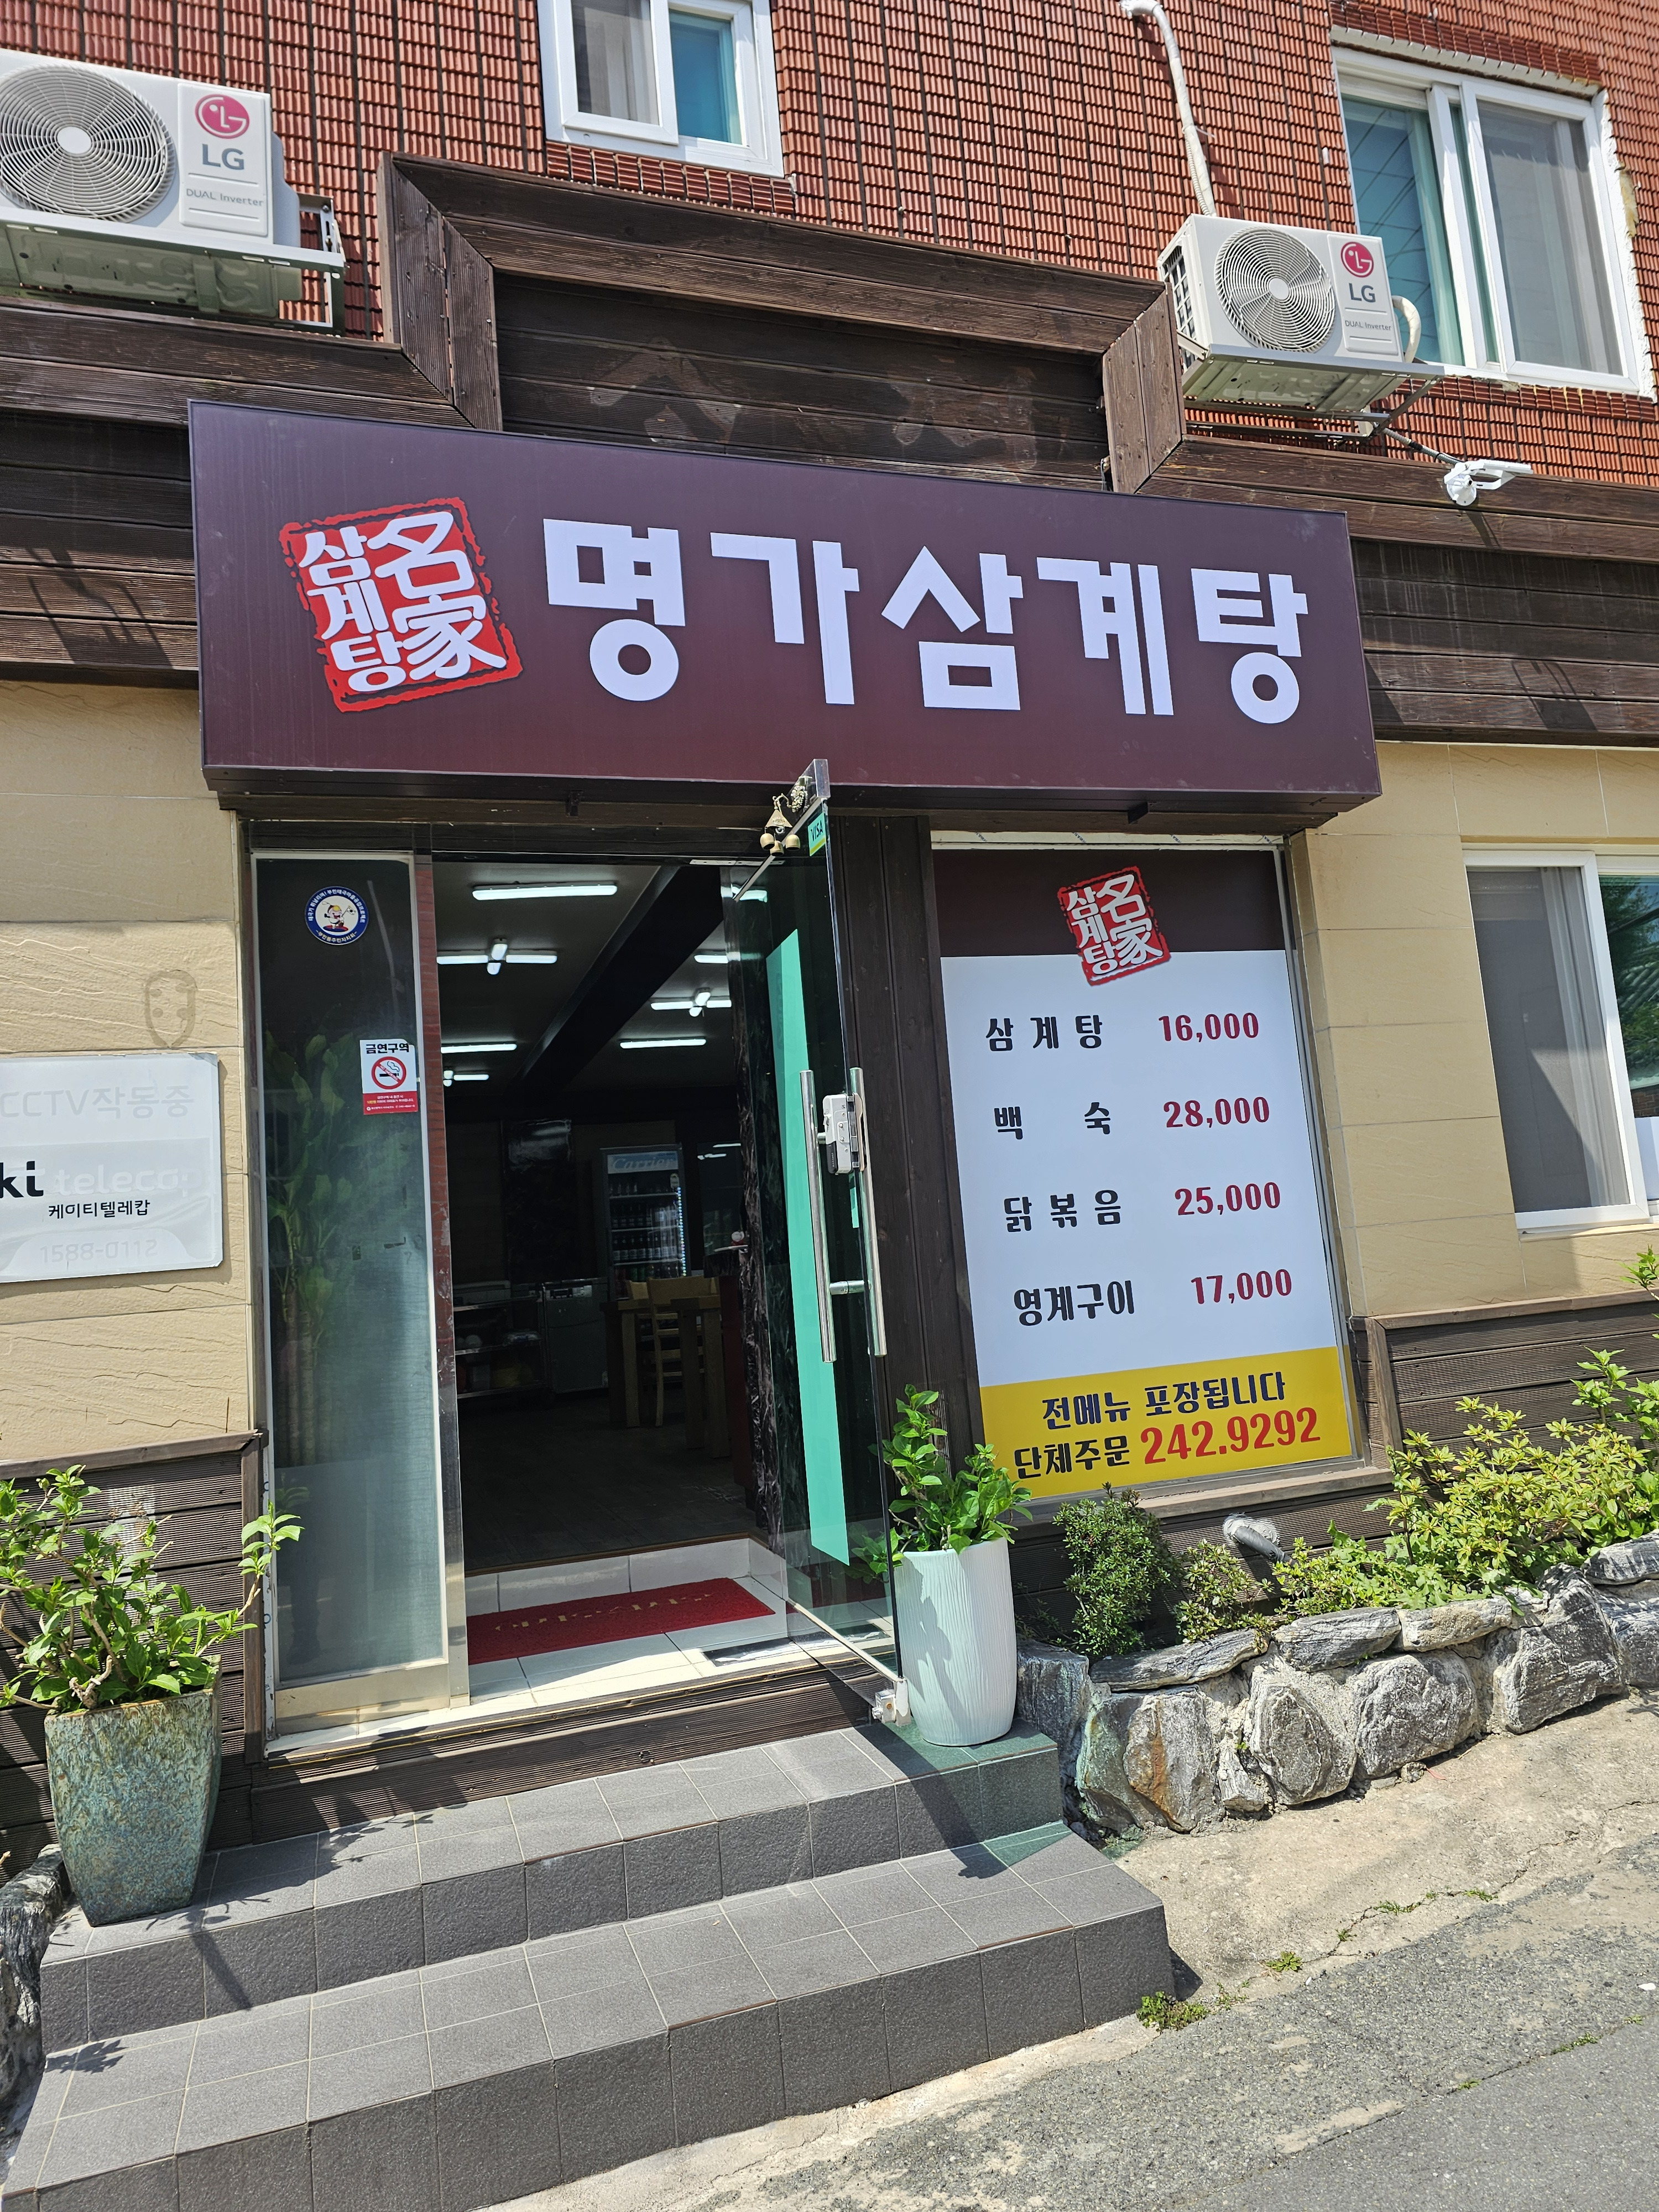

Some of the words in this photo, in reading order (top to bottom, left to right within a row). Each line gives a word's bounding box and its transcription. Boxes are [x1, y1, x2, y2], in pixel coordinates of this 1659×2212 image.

[202, 144, 244, 170] LG
[186, 189, 216, 200] DUAL
[220, 193, 264, 207] Inverter
[1349, 283, 1376, 303] LG
[1345, 320, 1363, 329] DUAL
[1365, 322, 1392, 331] Inverter
[298, 526, 406, 692] 삼계탕
[367, 511, 507, 681] 名家
[543, 518, 1308, 724] 명가삼계탕
[810, 820, 823, 841] VISA
[1066, 886, 1118, 974] 삼계탕
[1097, 874, 1164, 966] 名家
[366, 1042, 410, 1054] 금연구역
[985, 1015, 1103, 1052] 삼계탕
[1159, 1013, 1259, 1042] 16,000
[1, 1086, 195, 1119] CCTV작동중
[1163, 1096, 1270, 1128] 28,000
[48, 1199, 150, 1219] 케이티텔레캅
[1004, 1190, 1121, 1233] 닭볶음
[1174, 1182, 1281, 1215] 25,000
[40, 1239, 158, 1263] 1588-0112
[1014, 1280, 1134, 1326] 영계구이
[1191, 1269, 1292, 1305] 17,000
[1042, 1392, 1131, 1430] 전메뉴
[1144, 1371, 1286, 1417] 포장됩니다
[1014, 1435, 1130, 1479] 단체주문
[1140, 1407, 1321, 1464] 242.9292
